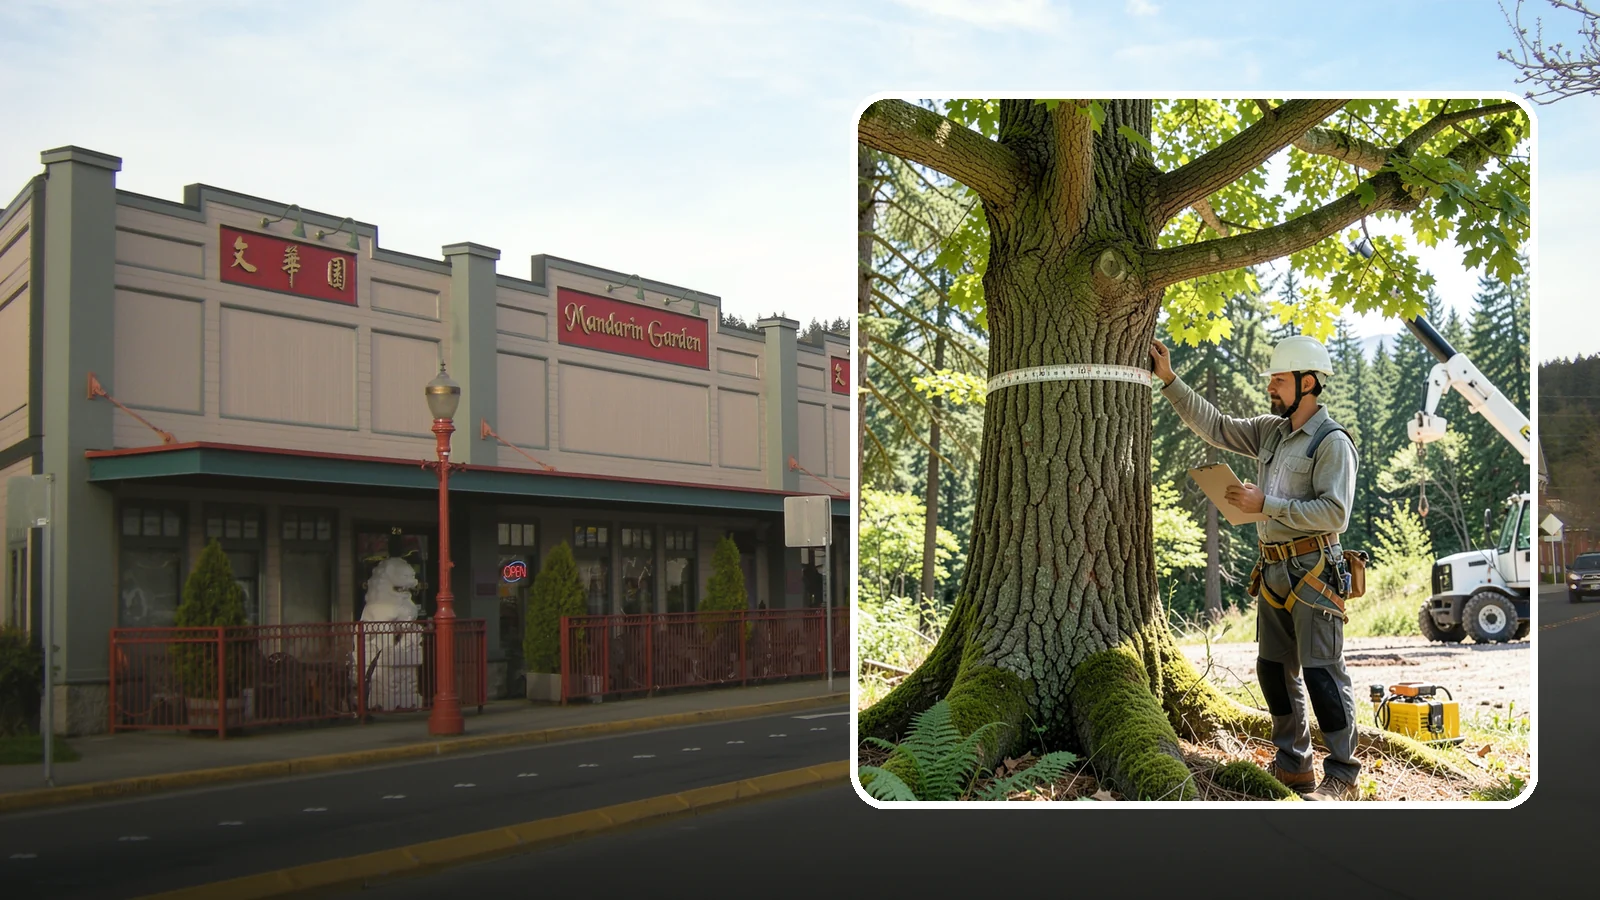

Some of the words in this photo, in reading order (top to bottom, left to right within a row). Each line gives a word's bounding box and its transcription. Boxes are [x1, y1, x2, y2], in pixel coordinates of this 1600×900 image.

[230, 235, 346, 291] 文華園
[564, 302, 645, 341] Mandarin
[647, 320, 702, 352] Garden
[503, 565, 527, 578] OPEN
